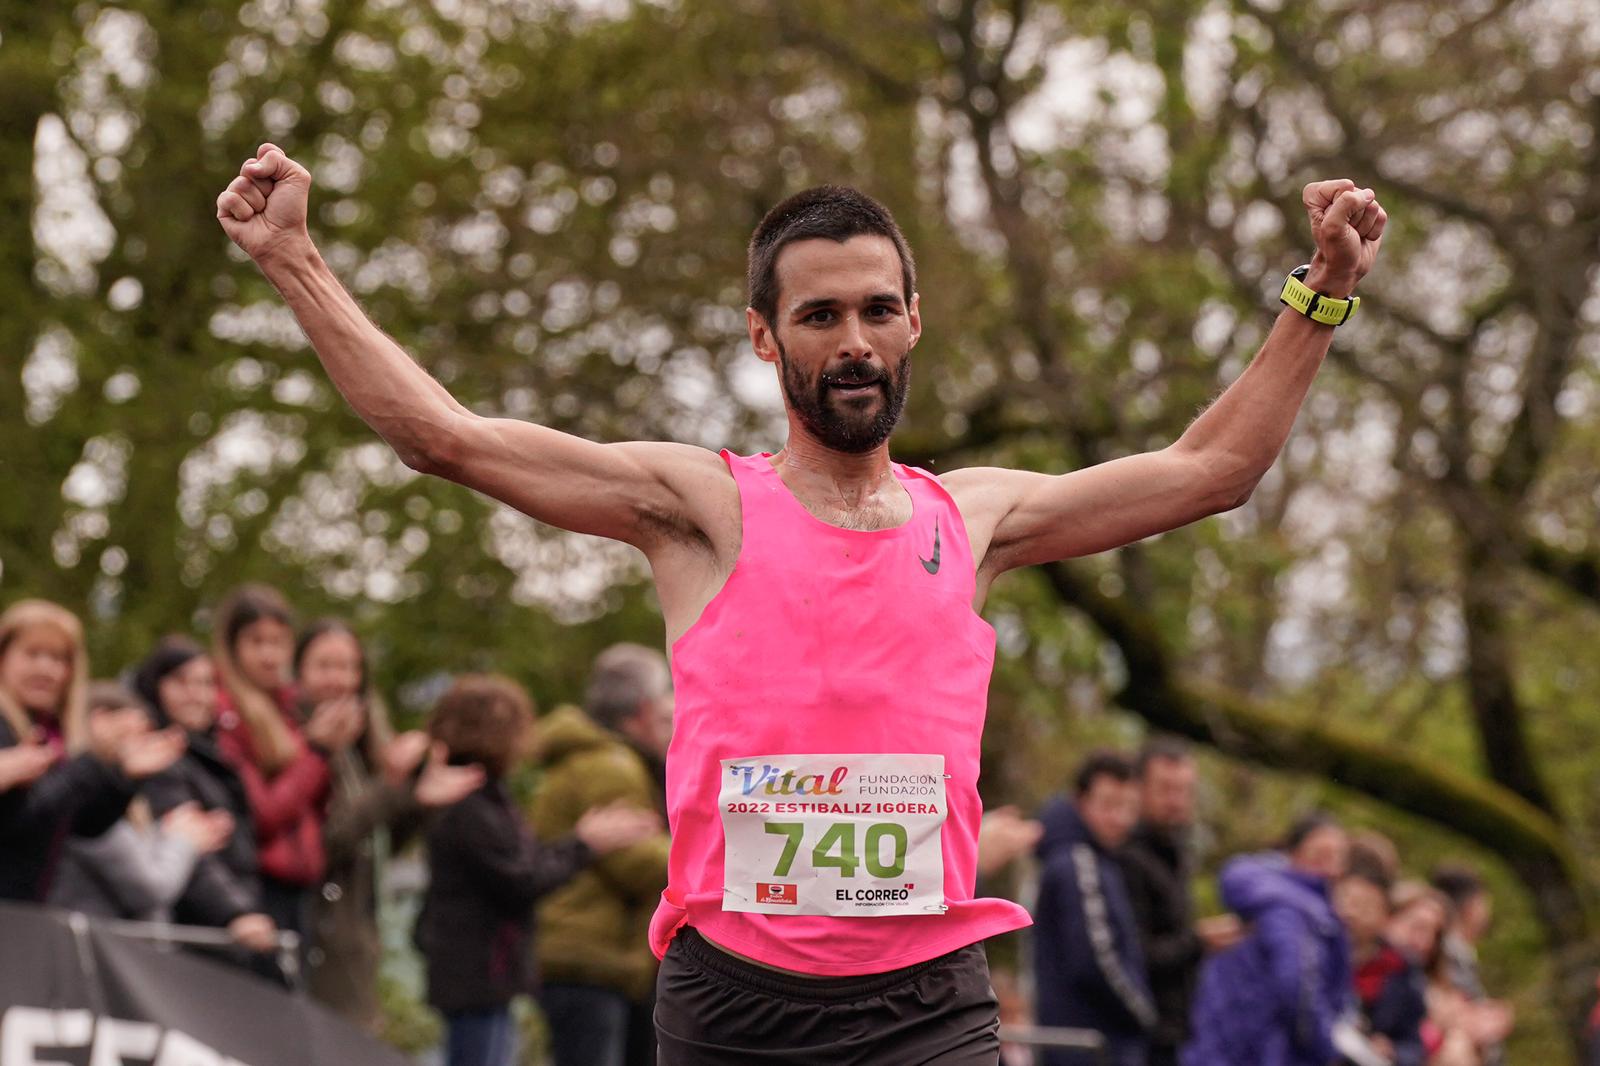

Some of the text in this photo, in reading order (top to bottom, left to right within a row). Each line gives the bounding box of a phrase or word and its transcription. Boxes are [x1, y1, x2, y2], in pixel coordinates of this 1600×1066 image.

[729, 764, 848, 795] Vital
[859, 774, 937, 785] FUNDACIÓN
[859, 786, 937, 796] FUNDAZIOA
[727, 802, 938, 815] 2022 ESTIBALIZ IGOERA
[764, 822, 908, 879] 740
[836, 889, 909, 901] EL CORREO
